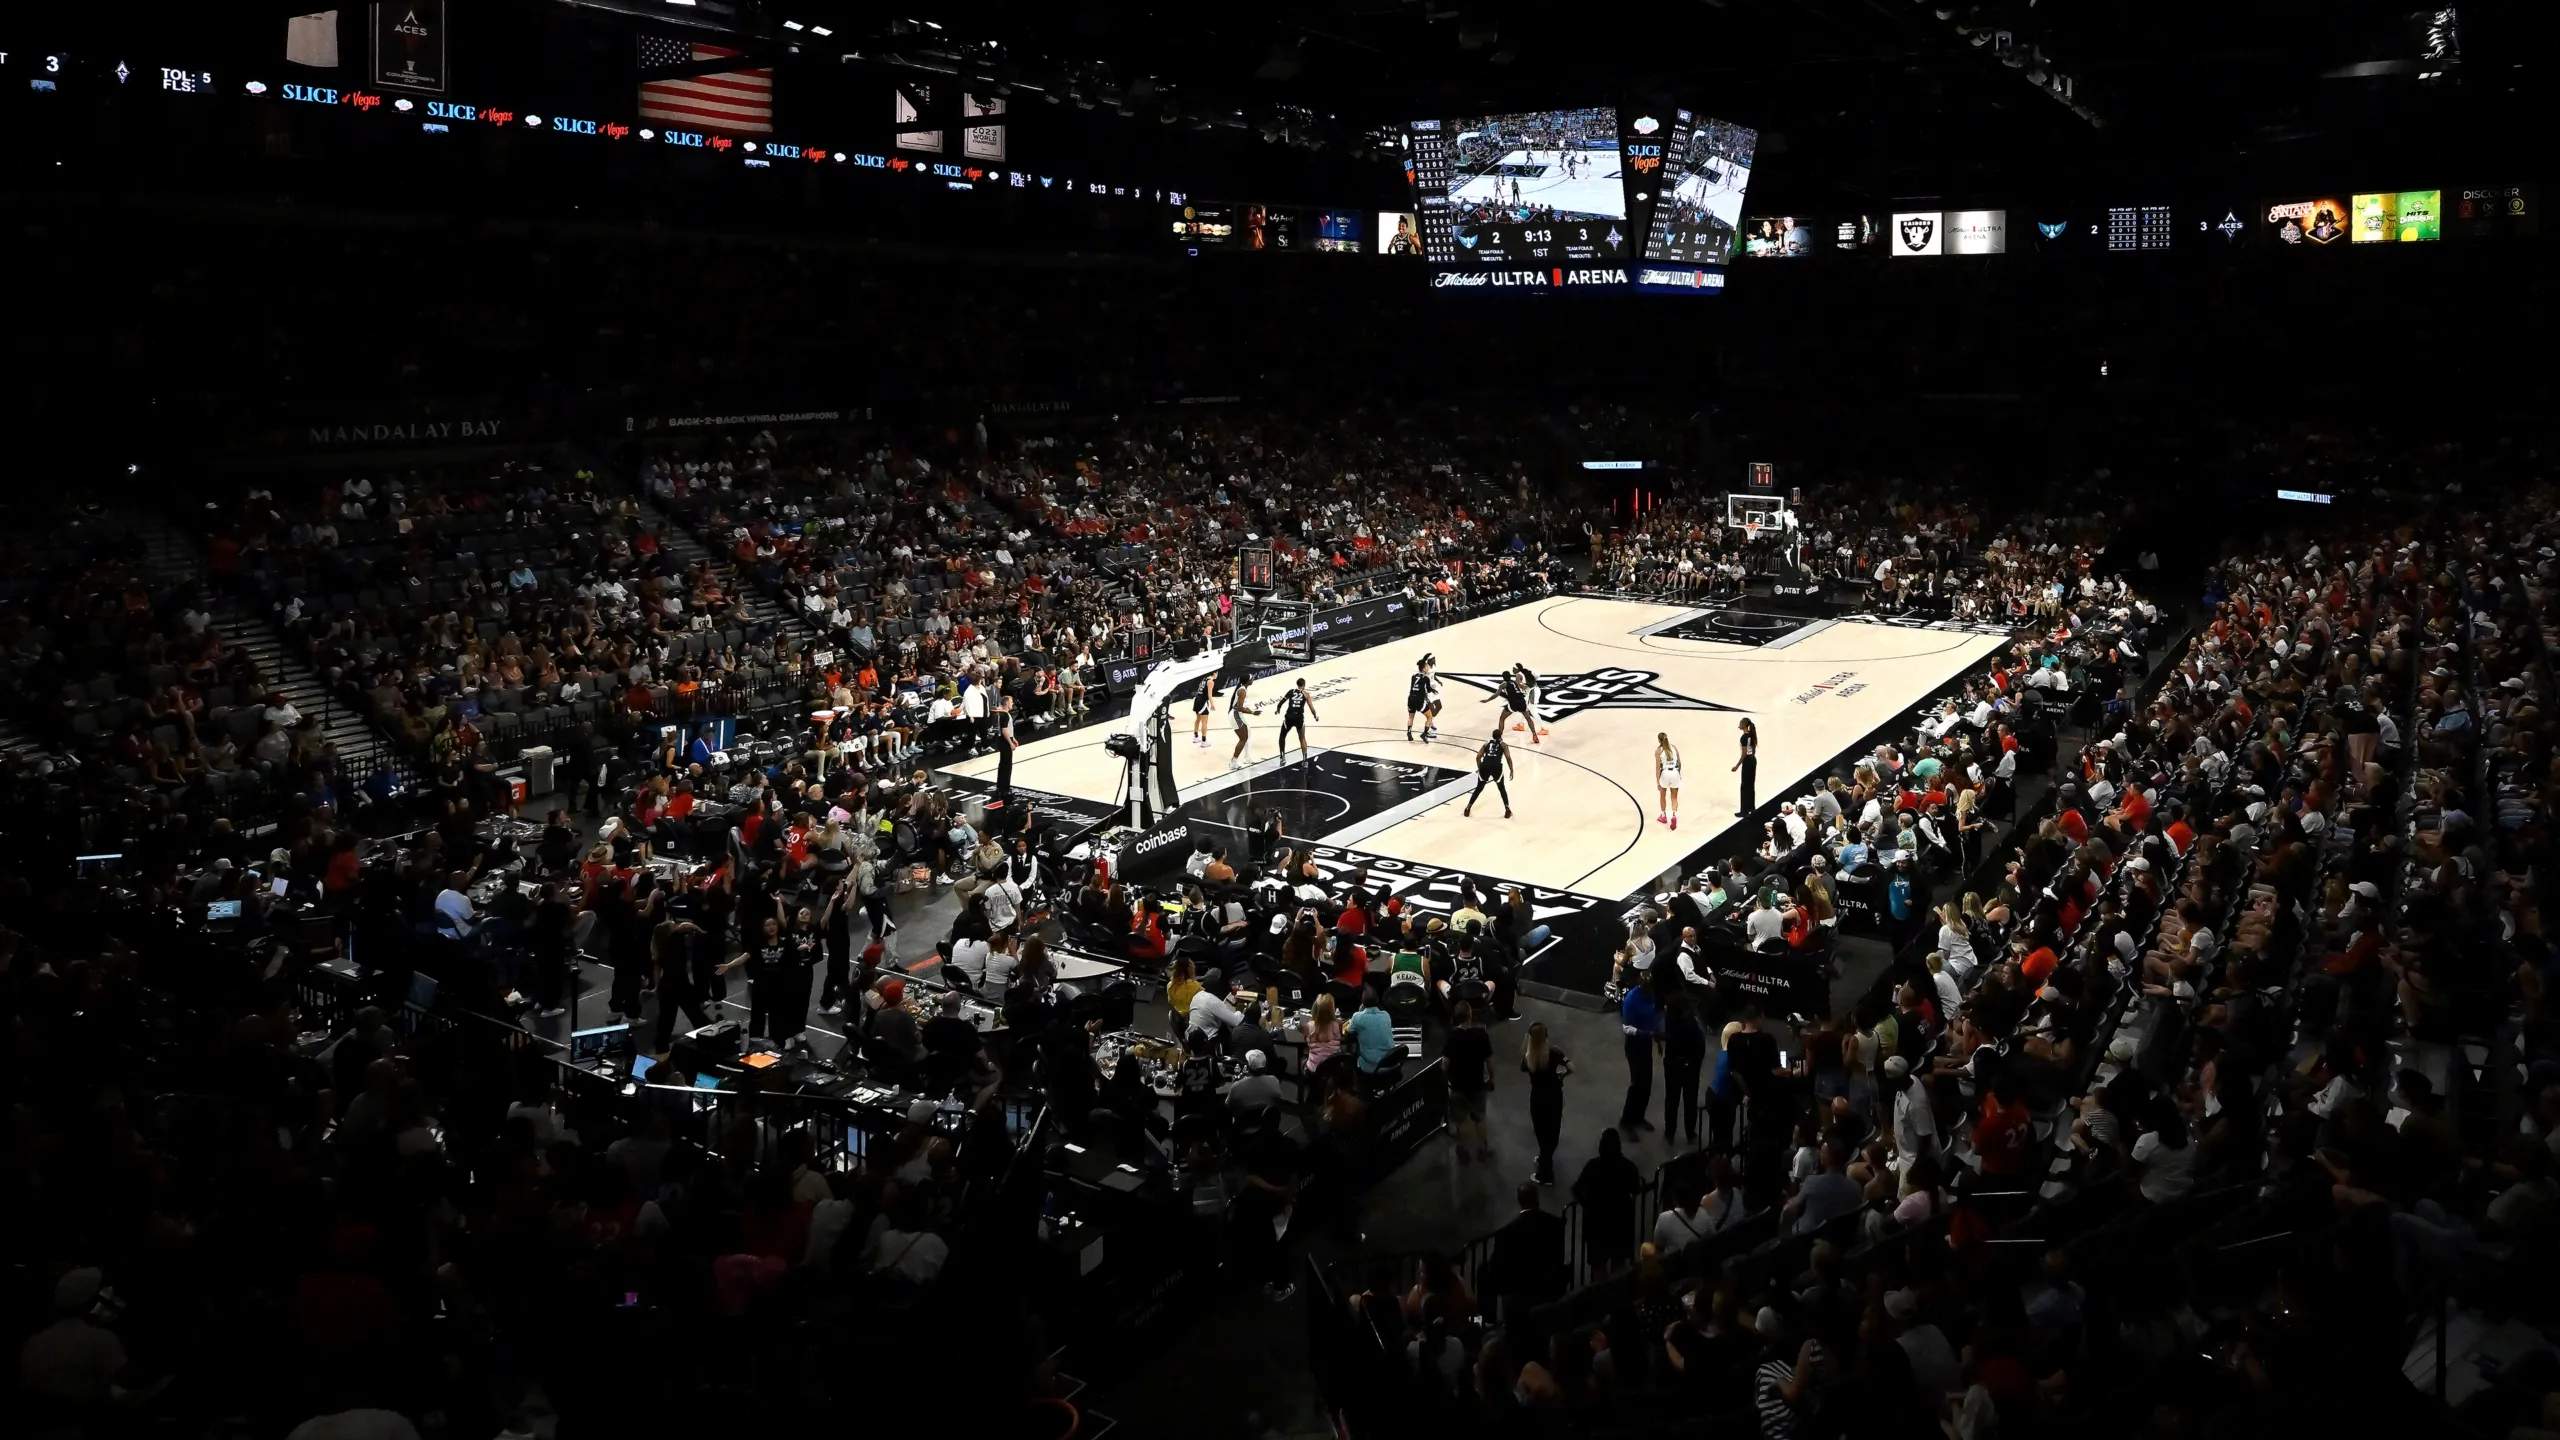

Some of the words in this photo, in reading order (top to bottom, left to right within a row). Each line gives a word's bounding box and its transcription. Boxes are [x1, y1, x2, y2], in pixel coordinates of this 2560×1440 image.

[394, 24, 427, 36] ACES
[46, 56, 59, 72] 3
[161, 67, 196, 82] TOL:
[202, 73, 211, 83] 5
[163, 79, 196, 92] FLS:
[283, 84, 338, 104] SLICE
[353, 90, 380, 110] Vegas
[427, 102, 475, 120] SLICE
[488, 107, 513, 126] Vegas
[553, 117, 596, 134] SLICE
[607, 122, 629, 139] Vegas
[972, 127, 997, 136] 2023
[665, 131, 703, 147] SLICE
[713, 136, 732, 152] Vegas
[973, 133, 997, 142] WORLD
[766, 143, 799, 158] SLICE
[808, 147, 826, 163] Vegas
[1628, 145, 1660, 156] SLICE
[854, 154, 884, 168] SLICE
[892, 157, 908, 172] Vegas
[1635, 153, 1660, 174] Vegas
[933, 163, 961, 177] SLICE
[968, 166, 982, 181] Vegas
[1067, 181, 1072, 190] 2
[1090, 184, 1106, 194] 9:13
[1135, 189, 1140, 198] 3
[2463, 188, 2519, 199] DISCOER
[2268, 202, 2314, 222] SANTANA
[2092, 226, 2098, 234] 2
[2201, 222, 2207, 230] 3
[1493, 232, 1500, 243] 2
[1525, 230, 1551, 242] 9:13
[1580, 229, 1587, 240] 3
[1680, 232, 1686, 243] 2
[1716, 236, 1720, 246] 3
[1533, 249, 1548, 257] 1ST
[1435, 272, 1489, 287] Michelob
[1492, 271, 1547, 285] ULTRA
[1568, 269, 1628, 284] ARENA
[1672, 272, 1694, 285] ULTRA
[1702, 273, 1724, 287] ARENA
[668, 414, 745, 427] BACK-2-BACK
[747, 413, 777, 423] WNBA
[779, 411, 839, 421] CHAMPIONS
[310, 422, 452, 443] MANDALAY
[460, 420, 501, 437] BAY
[1758, 473, 1768, 484] 11
[1335, 614, 1353, 625] Google
[1122, 668, 1137, 679] AT&T
[1821, 672, 1859, 686] ULTRA
[1292, 692, 1303, 701] 22
[787, 832, 800, 844] 20
[1136, 825, 1188, 854] coinbase
[1311, 847, 1466, 884] VEGAS
[1060, 890, 1072, 903] 20
[1267, 889, 1277, 903] H
[1496, 881, 1600, 909] LAS
[1838, 899, 1869, 910] ULTRA
[1396, 974, 1417, 983] KEMP
[1459, 967, 1479, 981] 22
[1718, 967, 1751, 980] Michelob
[1757, 974, 1790, 988] ULTRA
[1739, 983, 1769, 995] ARENA
[1185, 1067, 1209, 1086] 22
[1402, 1096, 1425, 1119] ULTRA
